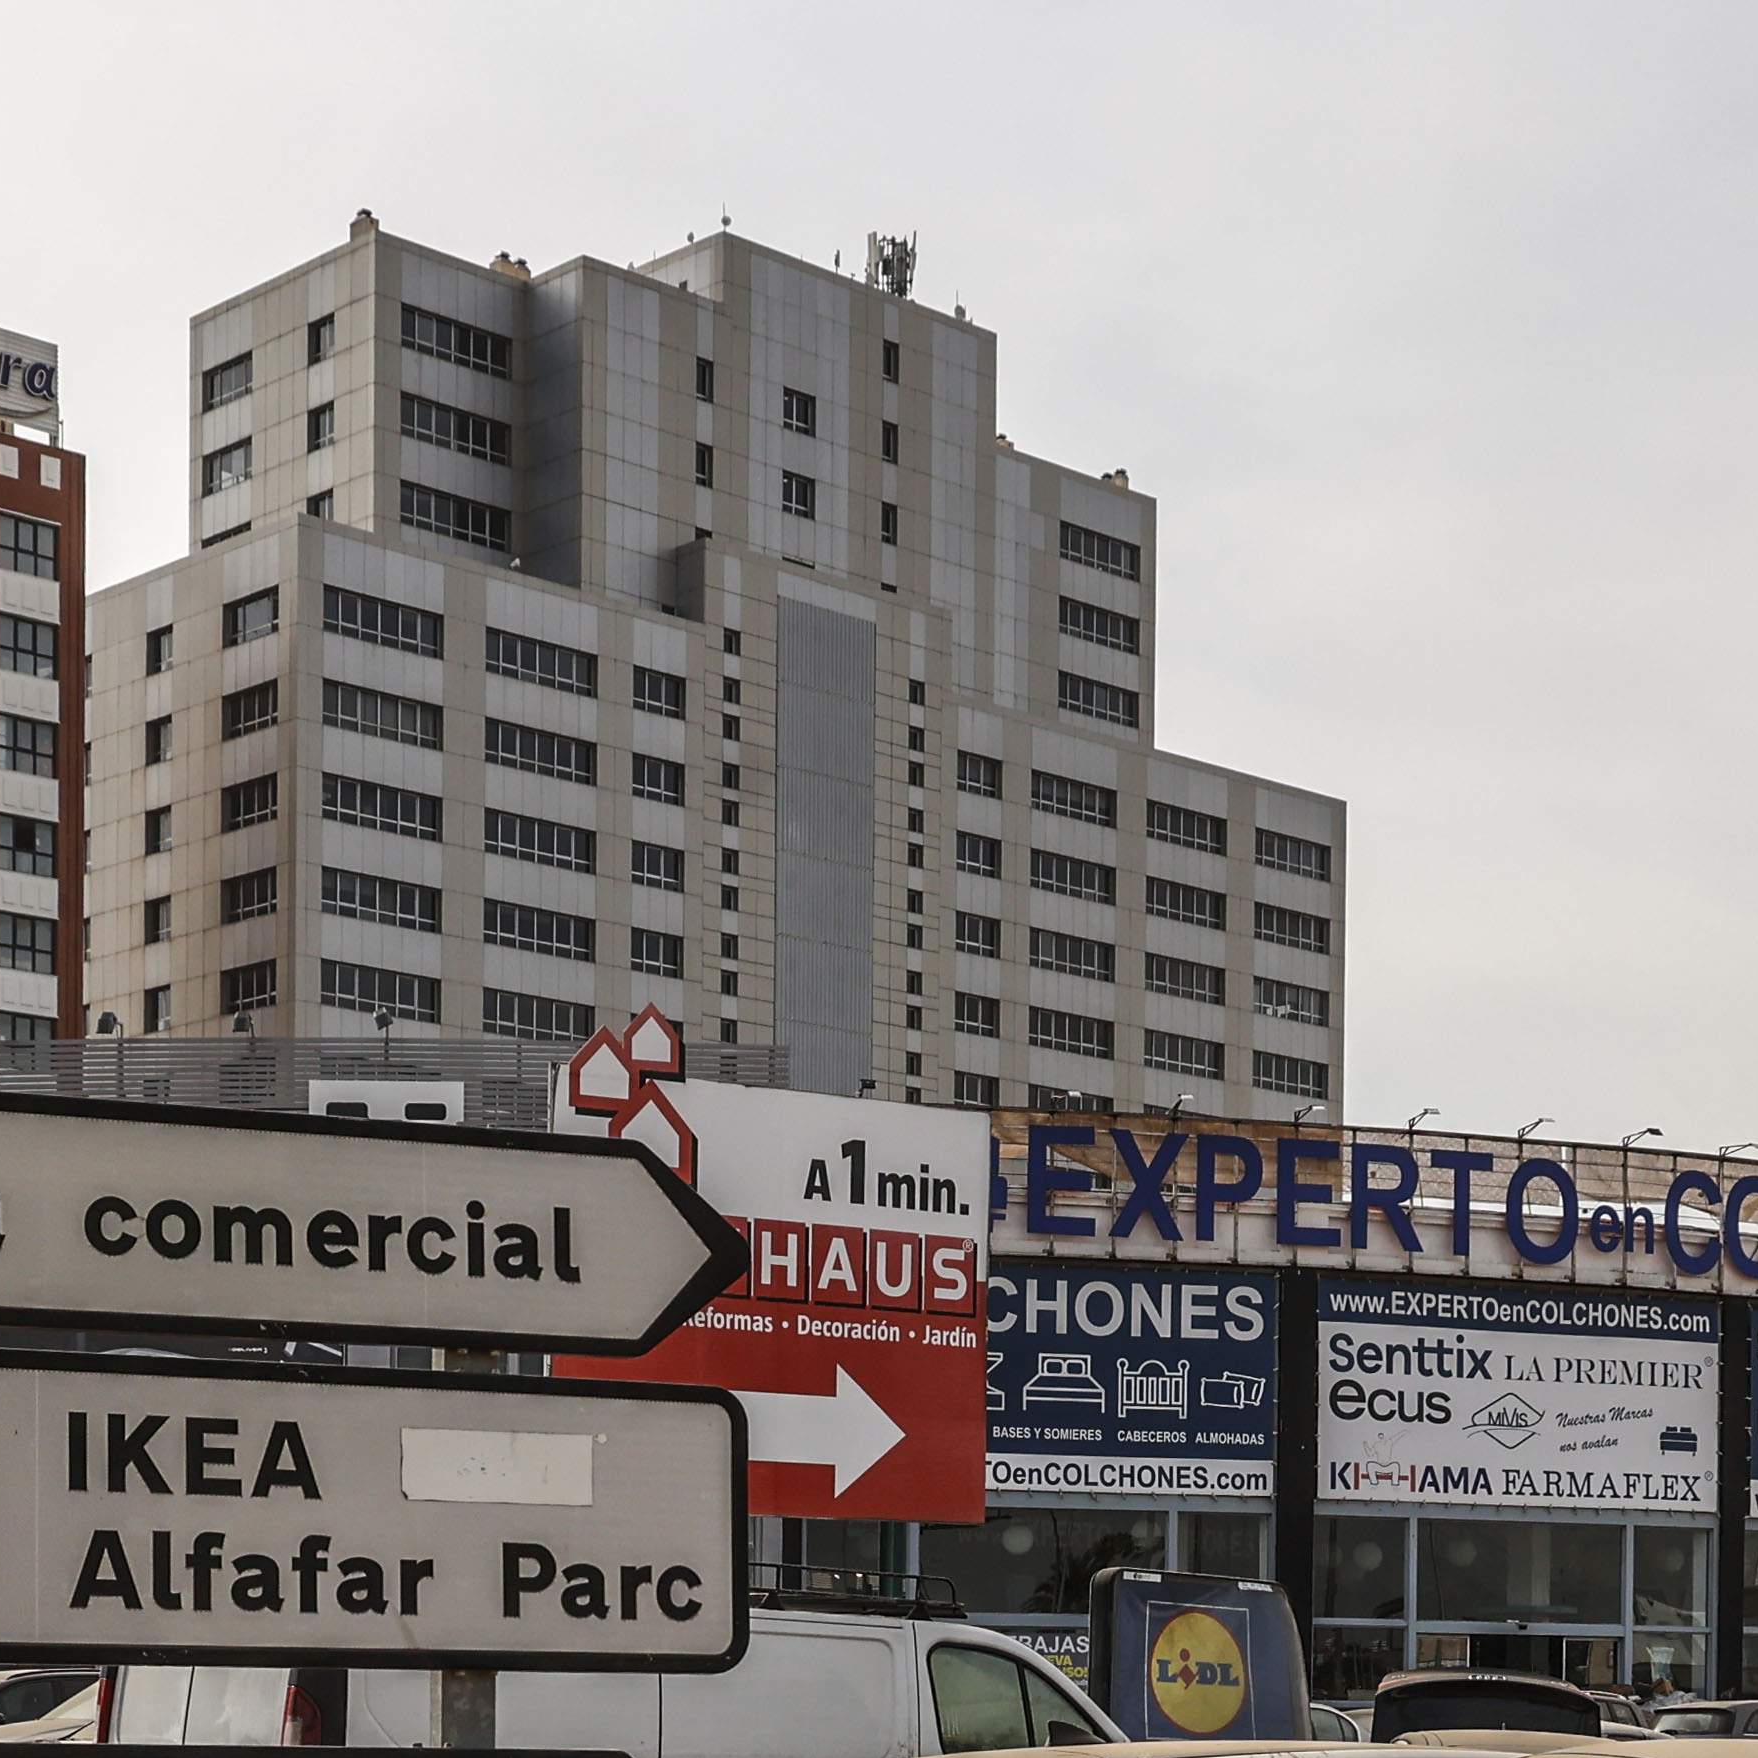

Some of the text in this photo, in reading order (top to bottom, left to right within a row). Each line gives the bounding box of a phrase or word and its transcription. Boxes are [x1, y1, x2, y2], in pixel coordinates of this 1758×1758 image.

[803, 1158, 832, 1202] A
[841, 1139, 866, 1205] 1
[877, 1163, 970, 1216] min.
[1026, 1125, 1578, 1266] EXPERTO
[1589, 1204, 1655, 1255] en
[83, 1194, 581, 1284] comercial
[758, 1228, 971, 1301] HAUS
[797, 1313, 900, 1342] Decoración
[922, 1324, 977, 1348] Jardín
[987, 1276, 1265, 1342] CHONES
[1329, 1290, 1711, 1333] www.EXPERTOenCOLCHONES.com
[1328, 1332, 1493, 1381] Senttix
[1504, 1354, 1704, 1390] LA PREMIER
[1328, 1379, 1452, 1425] ecus
[1555, 1405, 1654, 1429] Nuestras Marcas
[67, 1411, 322, 1500] IKEA
[992, 1426, 1266, 1446] BASES Y SOMIERES CABECEROS ALMOHADAS
[1559, 1434, 1619, 1453] nos avalan
[986, 1459, 1268, 1491] OenCOLCHONES.com
[1502, 1468, 1702, 1502] FARMAFLEX
[68, 1529, 703, 1621] Alfafar Parc
